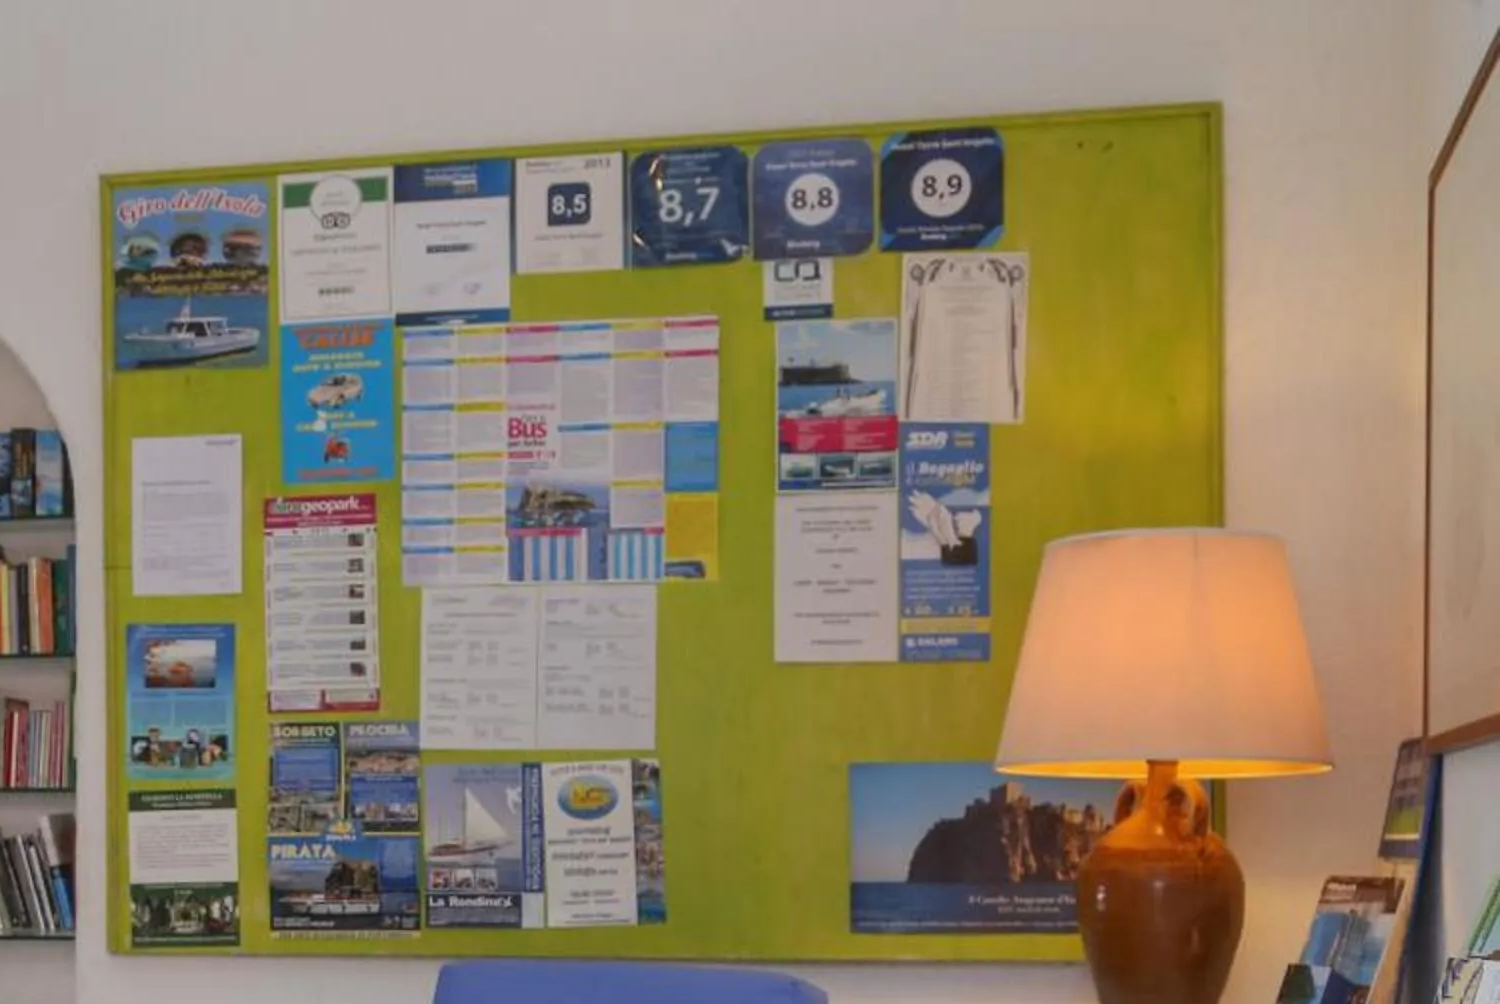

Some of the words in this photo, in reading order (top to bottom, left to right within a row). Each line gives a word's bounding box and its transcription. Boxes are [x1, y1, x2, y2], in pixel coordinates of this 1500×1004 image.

[791, 186, 833, 211] 8,8
[922, 174, 963, 200] 8,9
[552, 193, 587, 217] 8,5
[659, 186, 719, 227] 8,7
[508, 417, 548, 439] Bus
[271, 844, 337, 860] PIRATA
[429, 896, 444, 907] La
